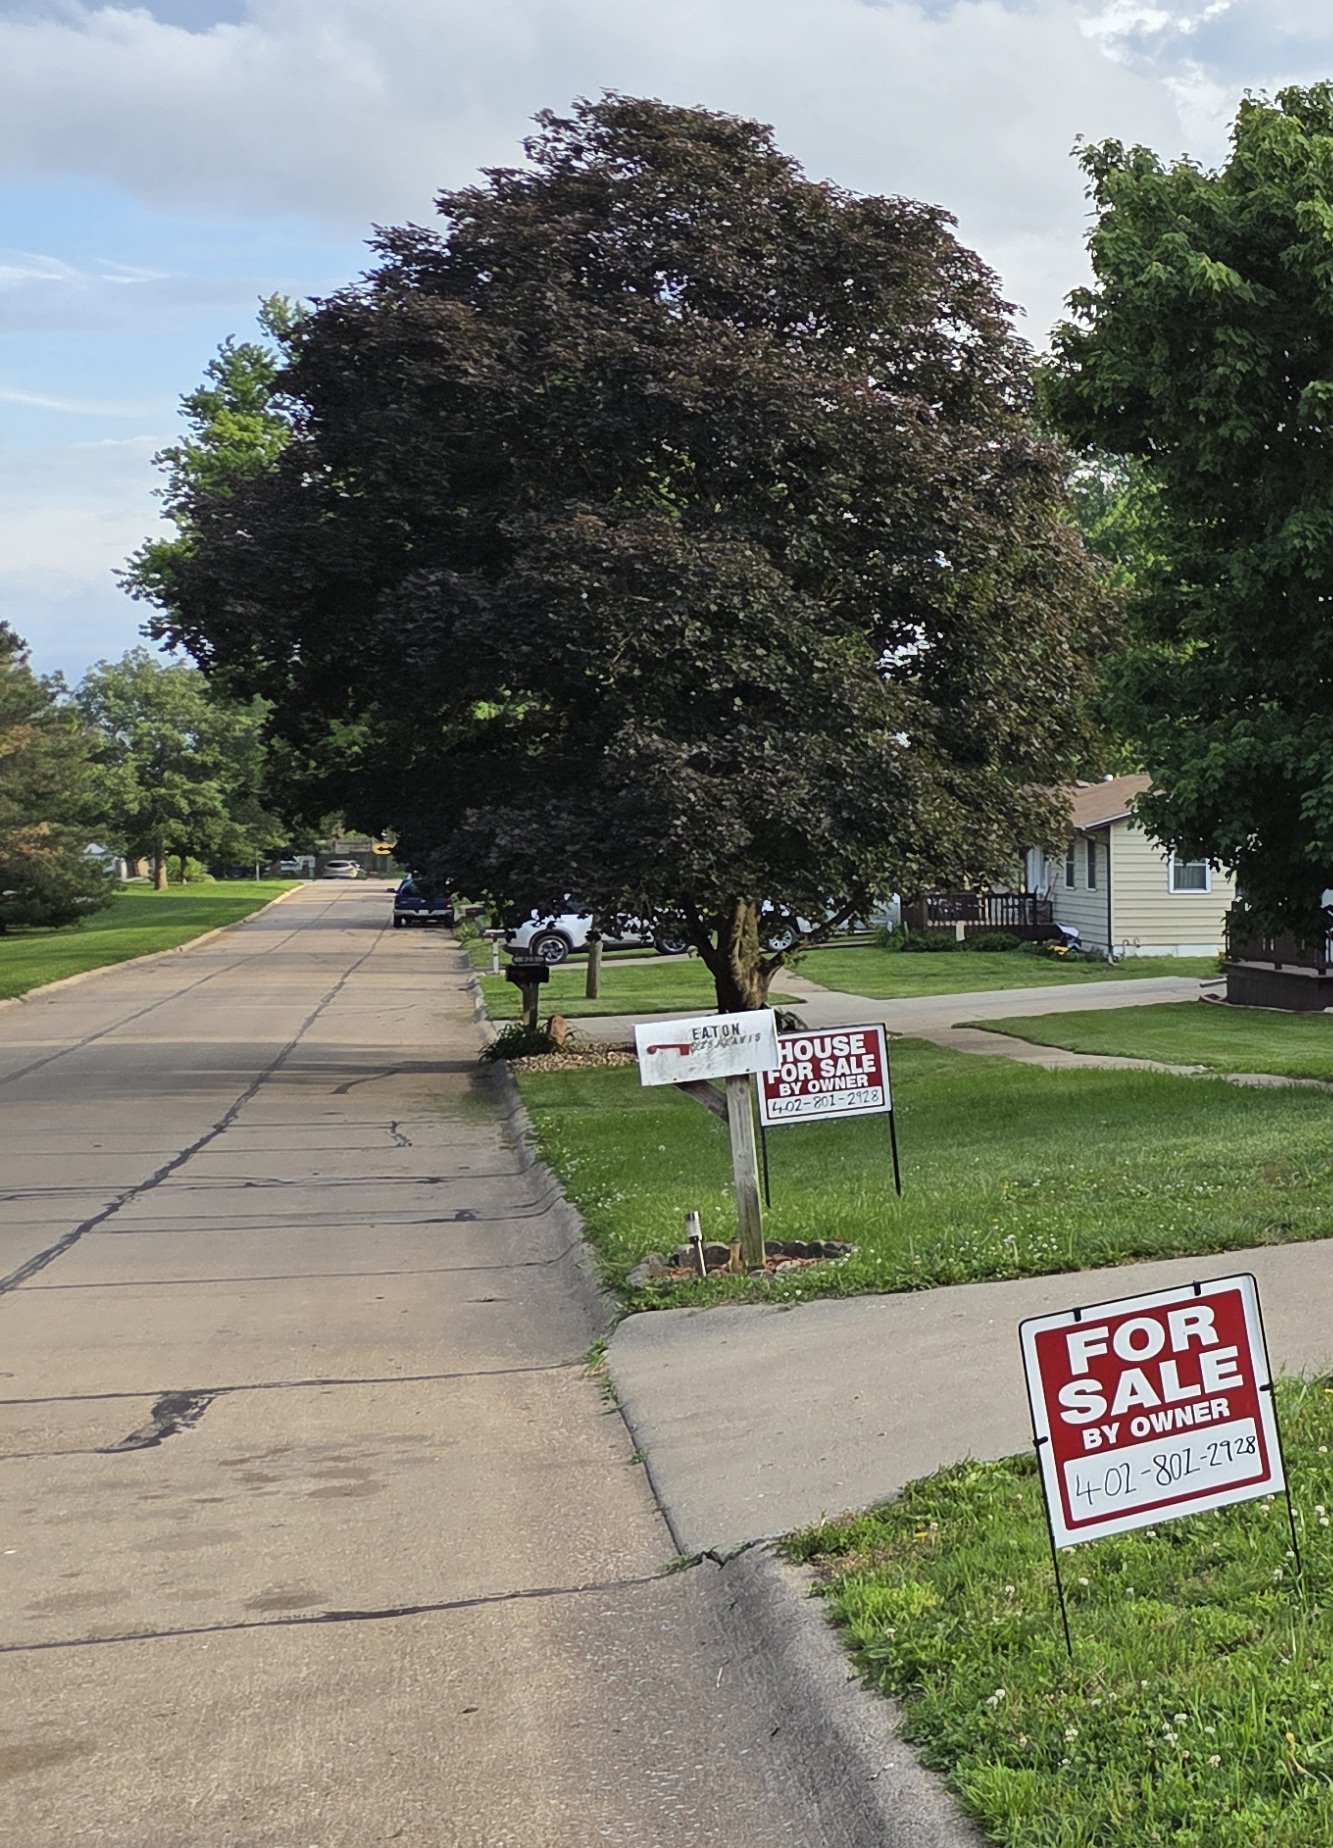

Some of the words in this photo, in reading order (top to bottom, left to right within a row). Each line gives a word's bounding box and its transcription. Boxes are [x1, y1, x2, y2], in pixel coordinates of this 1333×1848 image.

[692, 1023, 740, 1040] EATON
[780, 1034, 866, 1062] HOUSE
[768, 1062, 814, 1084] FOR
[820, 1054, 876, 1077] SALE
[779, 1082, 802, 1096] BY
[808, 1074, 869, 1093] OWNER
[772, 1089, 880, 1113] 402-801-2928
[1066, 1305, 1219, 1376] FOR
[1058, 1345, 1244, 1425] SALE
[1082, 1422, 1121, 1450] BY
[1130, 1397, 1230, 1438] OWNER
